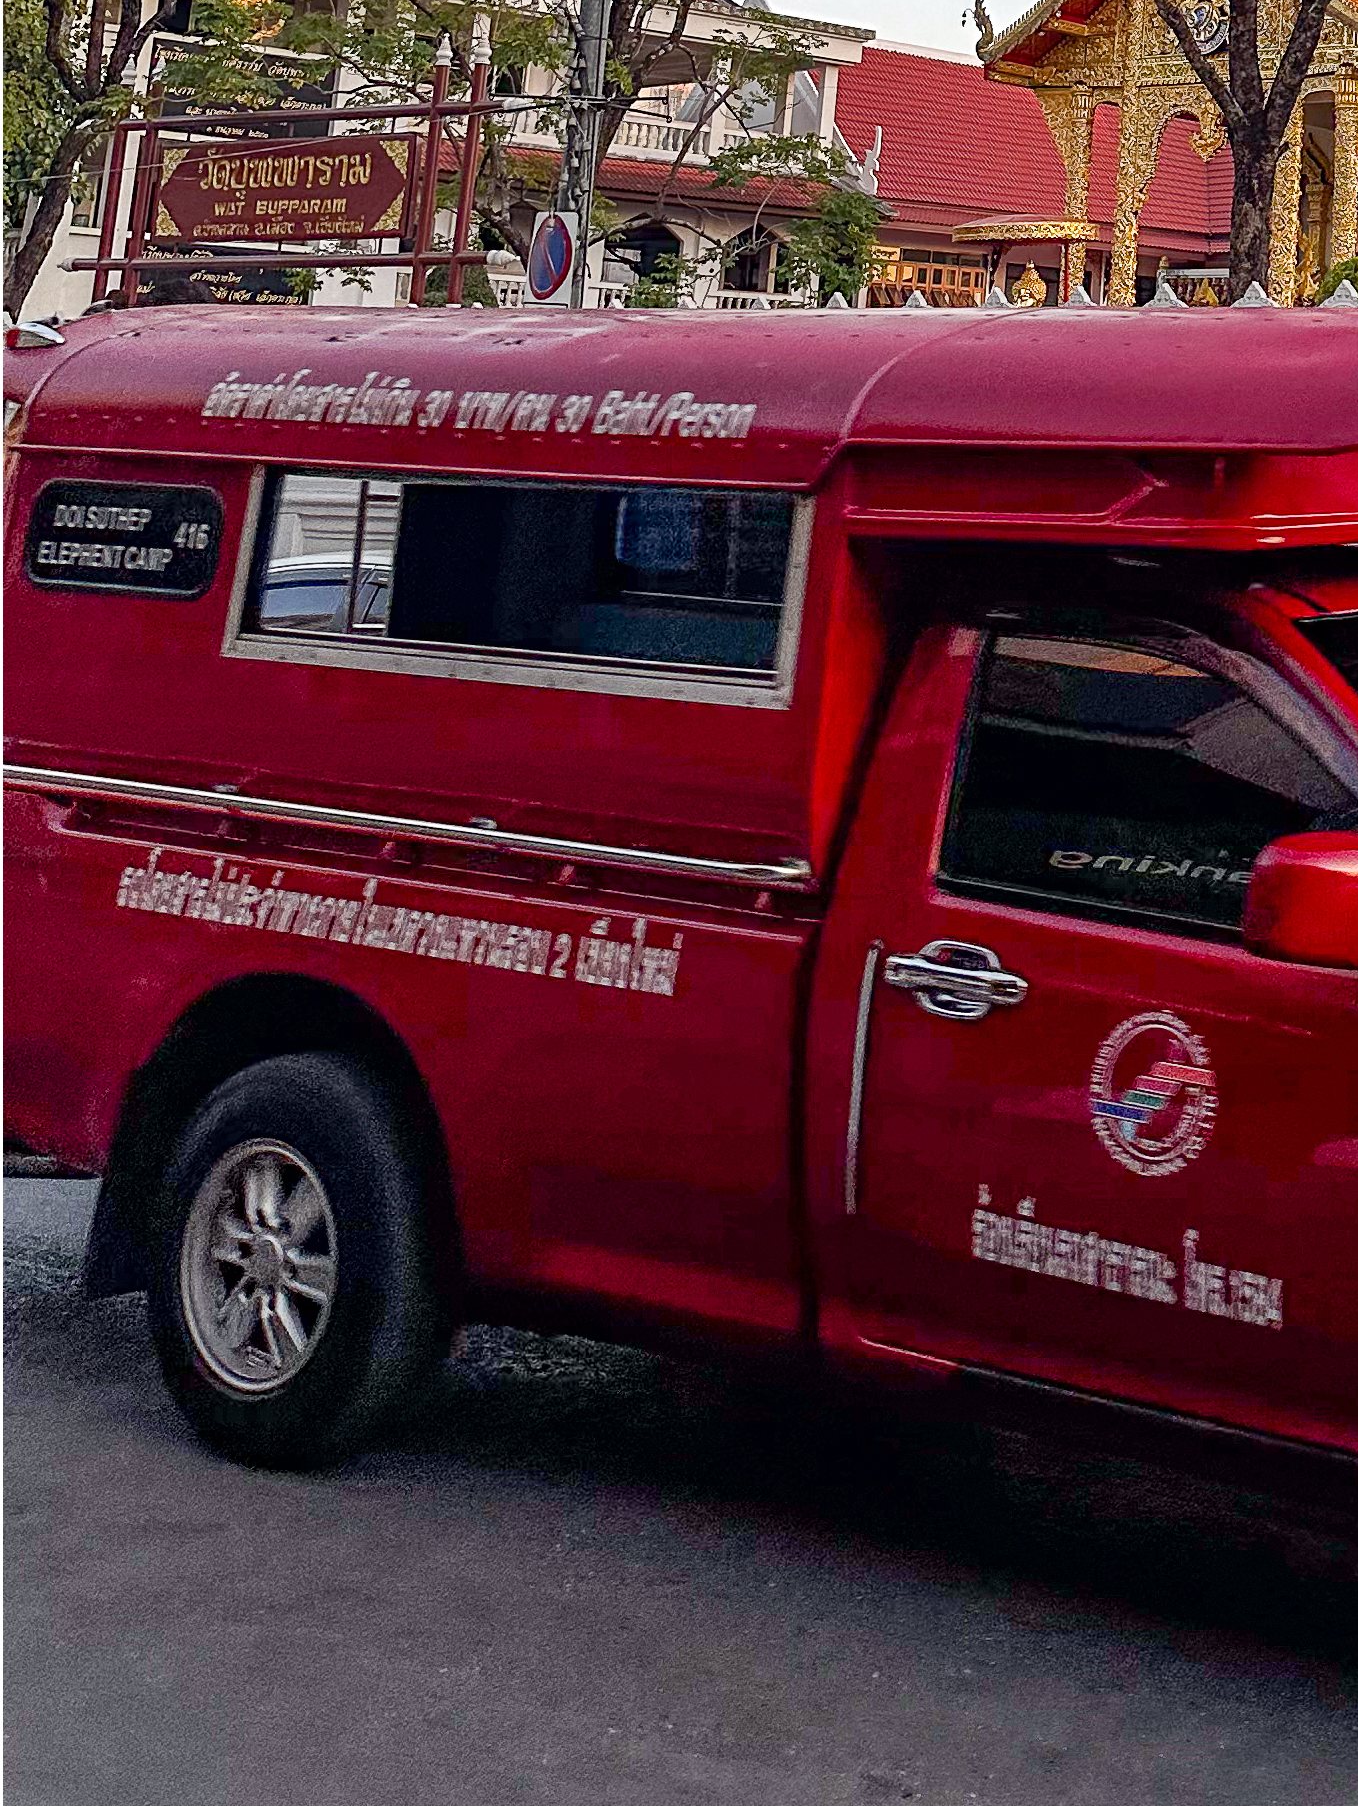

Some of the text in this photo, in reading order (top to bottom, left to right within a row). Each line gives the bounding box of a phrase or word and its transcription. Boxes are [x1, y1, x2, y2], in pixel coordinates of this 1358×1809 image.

[199, 148, 372, 199] วัดบุพพาราม
[214, 199, 347, 216] WAT BUPPARAM
[173, 522, 211, 549] 416
[550, 933, 571, 979] 2
